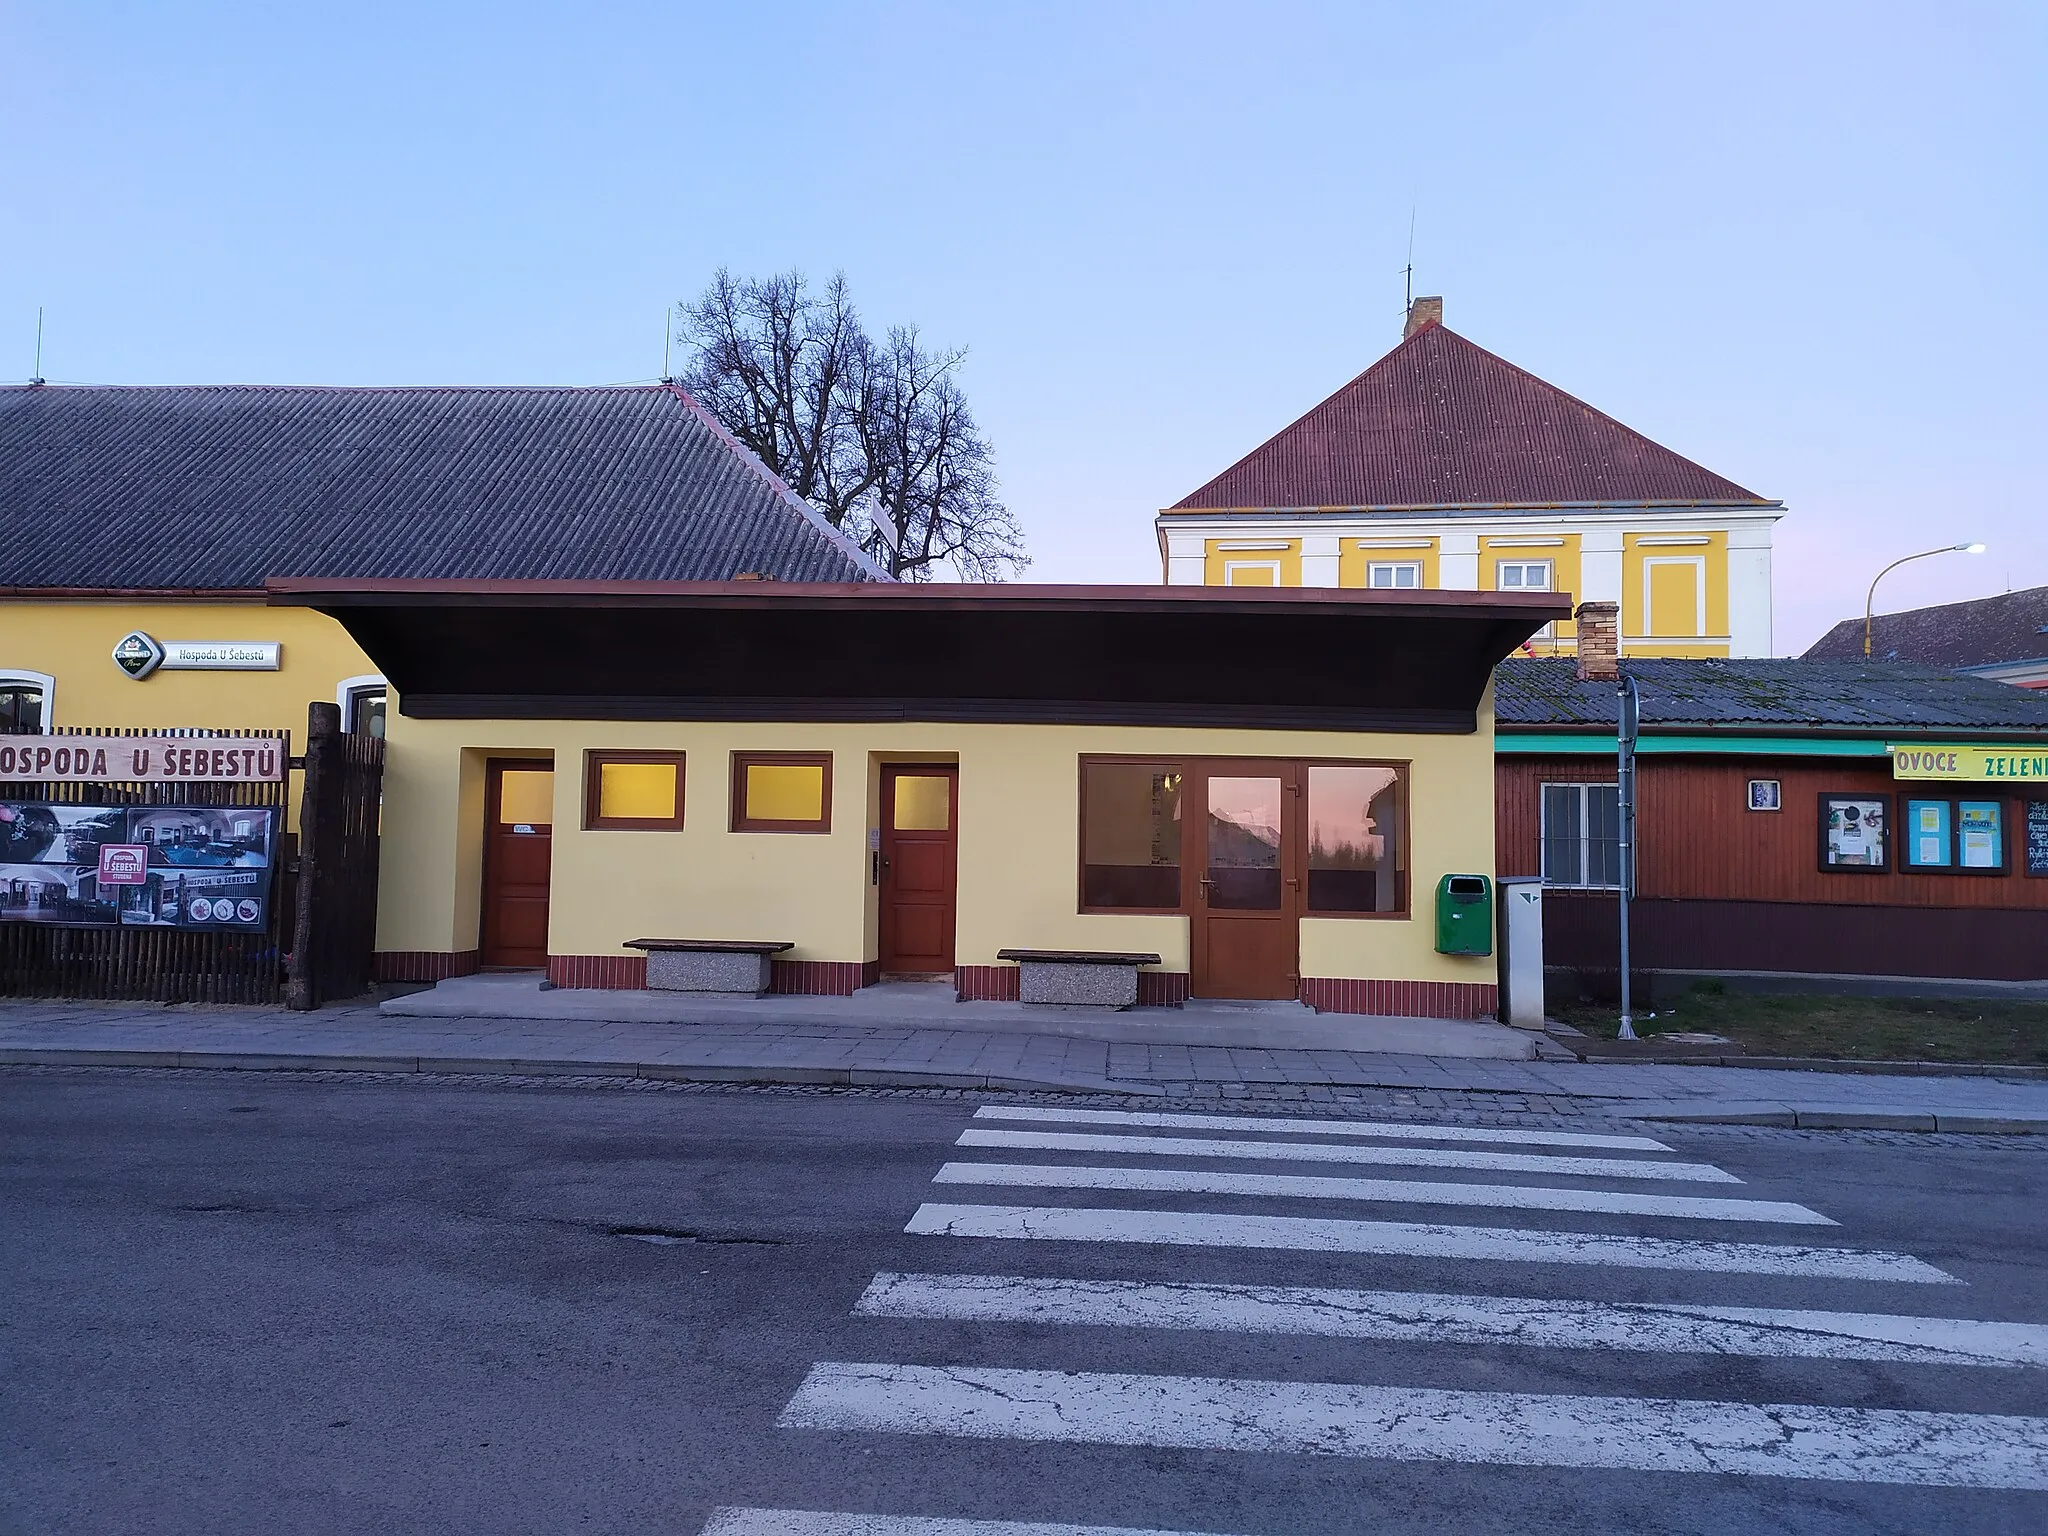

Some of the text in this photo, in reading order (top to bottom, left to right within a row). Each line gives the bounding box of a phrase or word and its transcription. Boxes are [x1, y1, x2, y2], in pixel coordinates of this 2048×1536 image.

[179, 647, 264, 662] Hospoda U Šebestů
[0, 743, 274, 777] OSPODA U ŠEBESTŮ
[1896, 751, 2048, 776] OVOCE ZELENI
